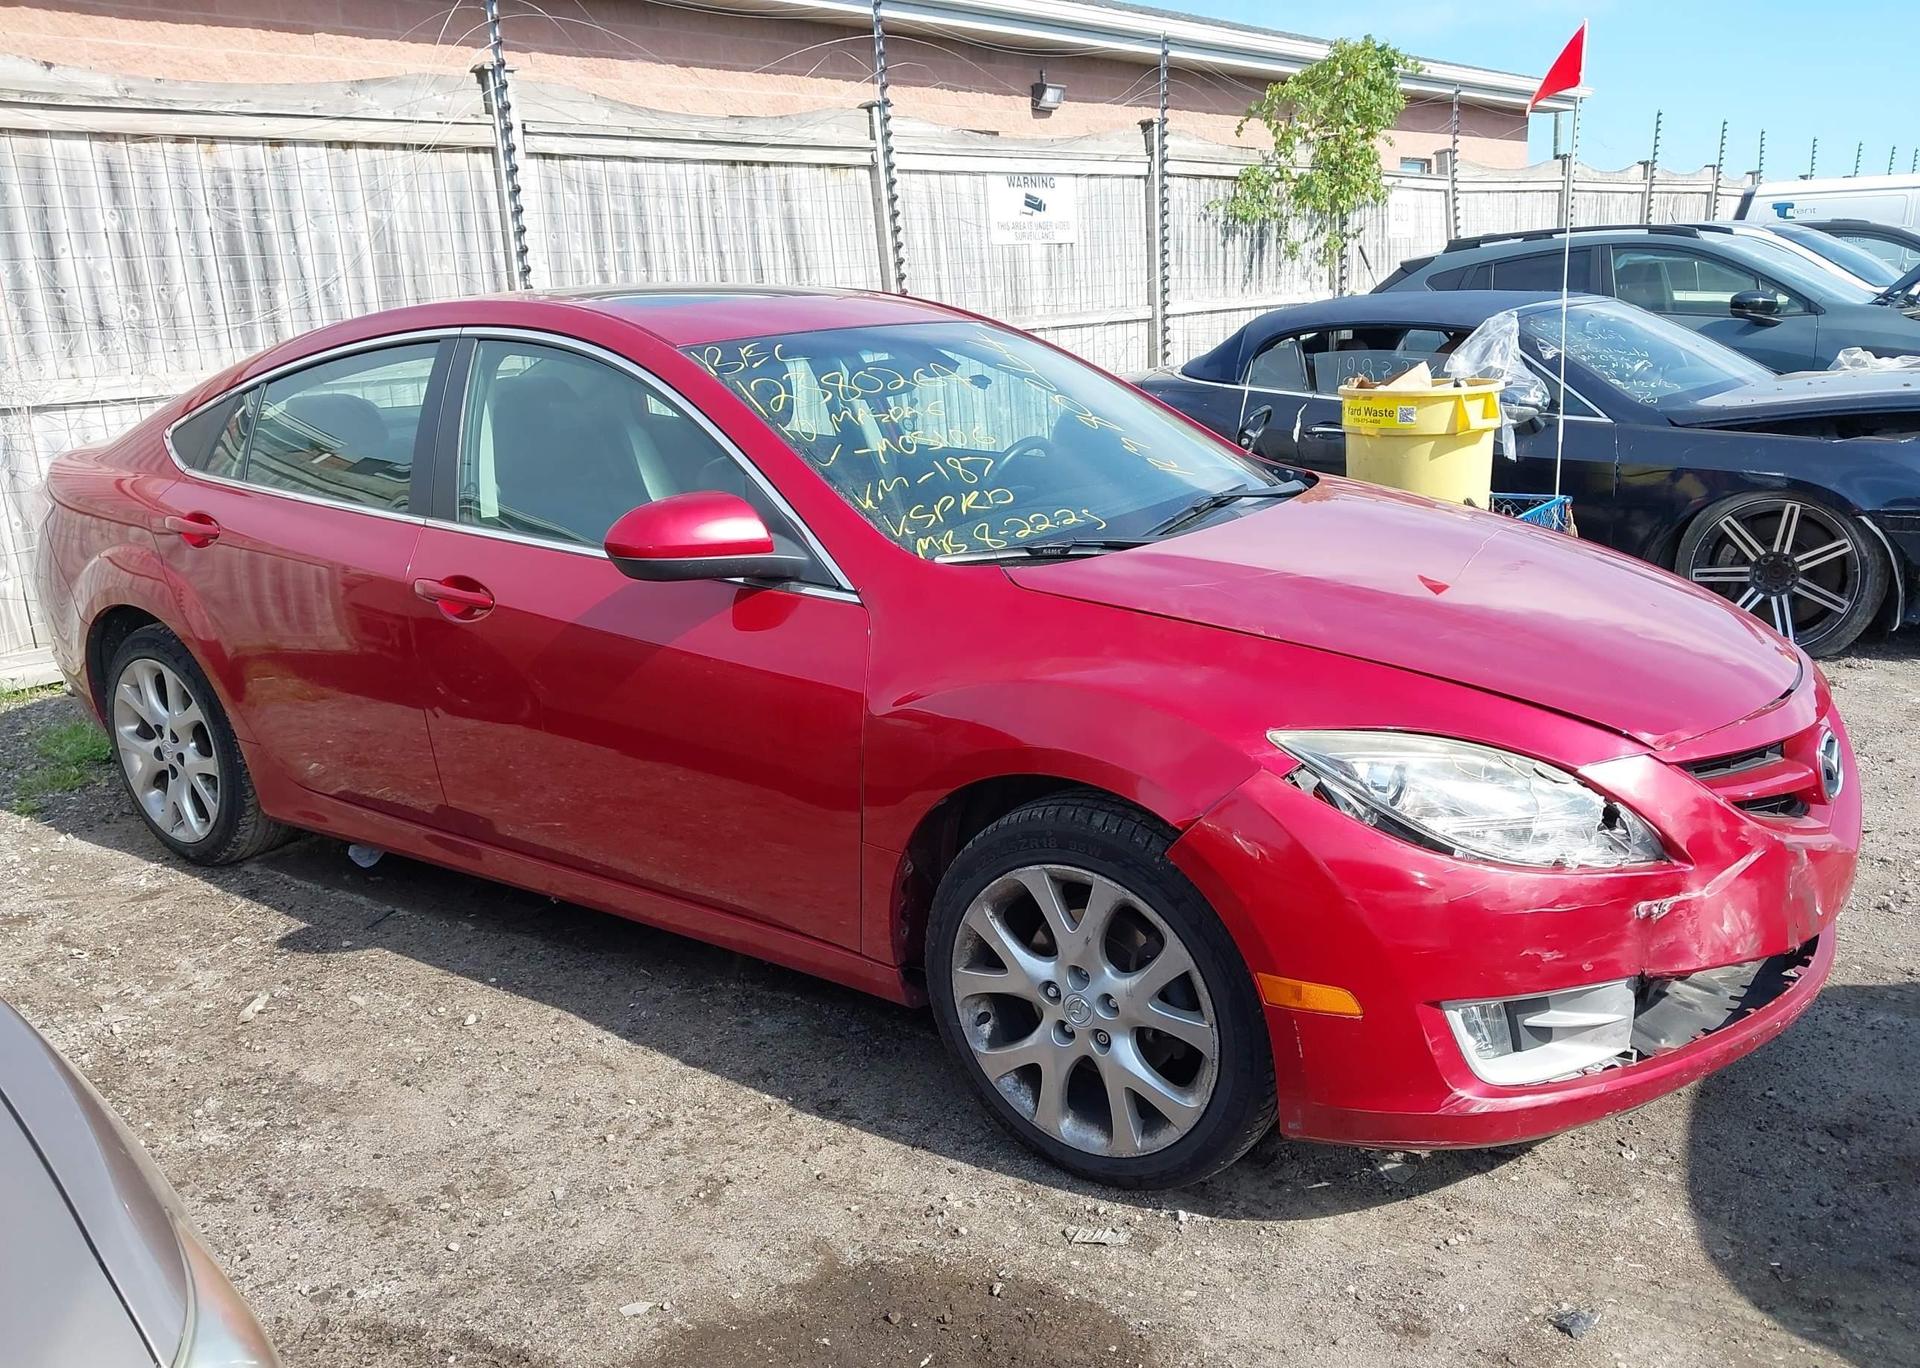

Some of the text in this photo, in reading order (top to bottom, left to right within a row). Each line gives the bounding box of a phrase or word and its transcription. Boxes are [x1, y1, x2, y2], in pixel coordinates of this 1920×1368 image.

[1006, 176, 1056, 189] WARNING
[997, 221, 1010, 231] THIS
[1011, 221, 1026, 231] AREA
[1027, 221, 1033, 231] IS
[1035, 220, 1053, 231] UNDER
[1015, 231, 1056, 241] SURVEILLANCE
[1363, 406, 1395, 418] Waste
